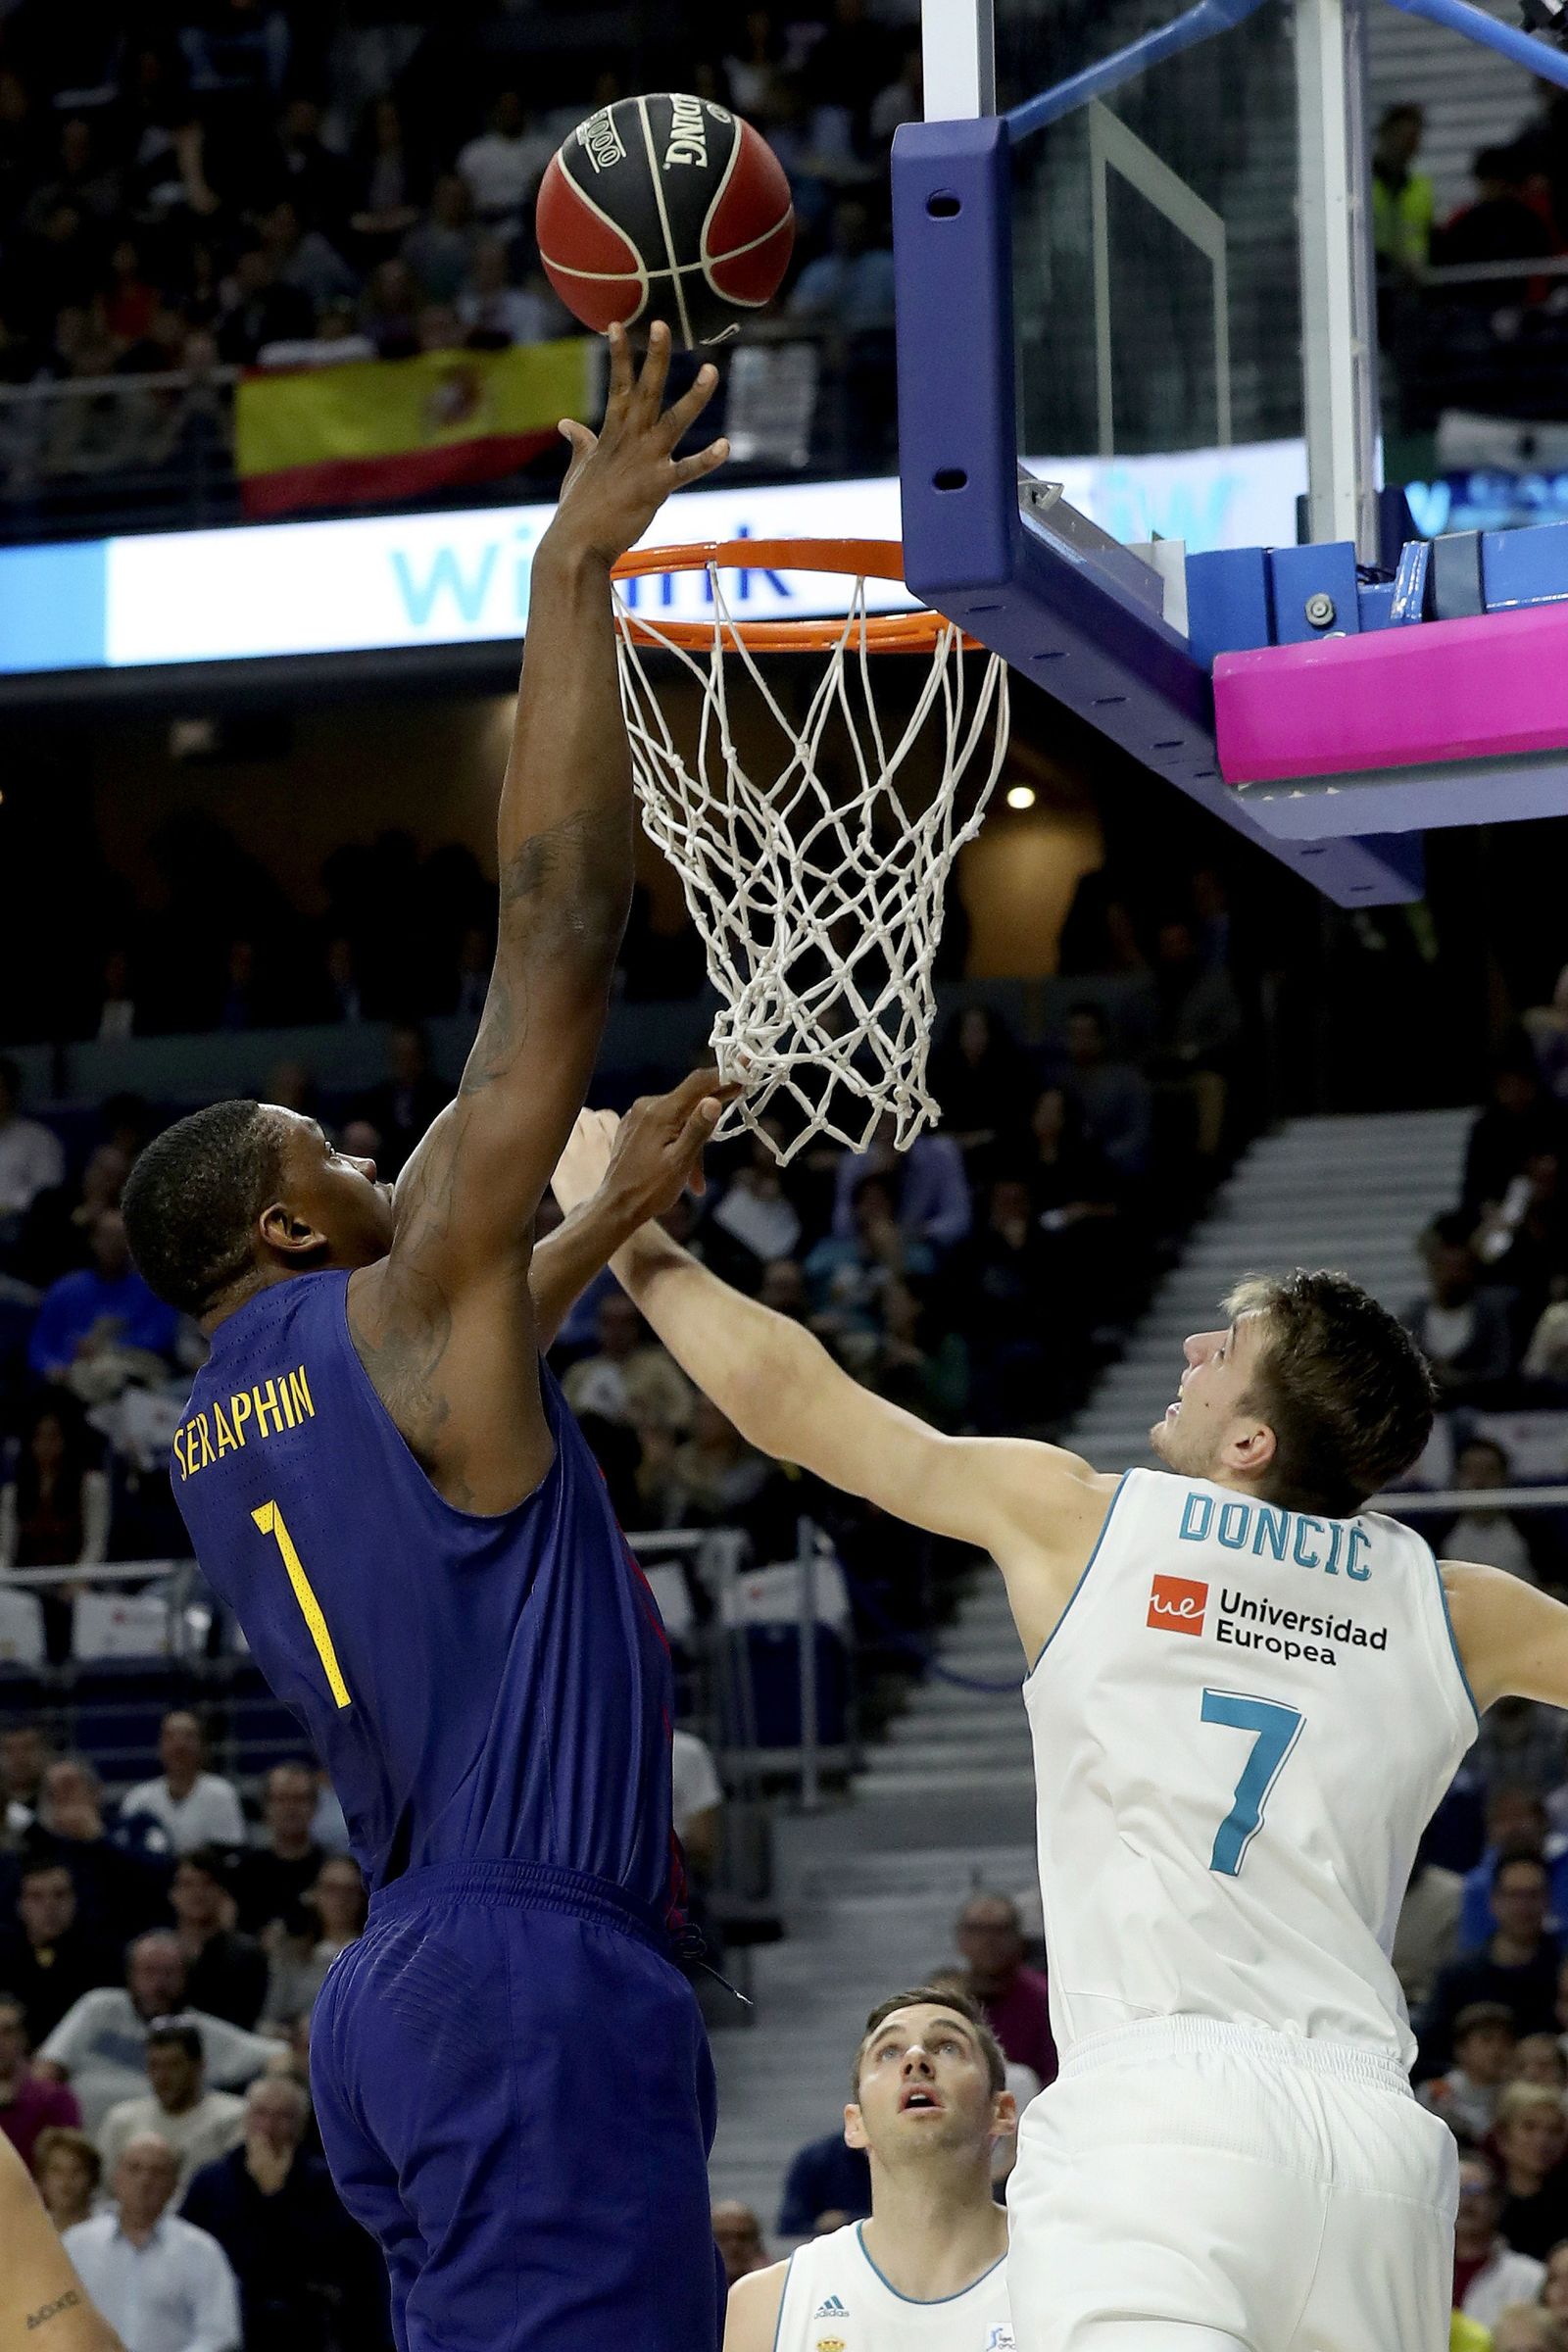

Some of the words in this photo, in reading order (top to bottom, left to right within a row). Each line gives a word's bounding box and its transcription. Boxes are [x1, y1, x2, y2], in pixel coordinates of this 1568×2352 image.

[172, 1364, 315, 1482] SERAPHIN
[251, 1499, 353, 1709] 1
[1215, 1619, 1337, 1666] Europea
[1219, 1588, 1388, 1651] Universidad
[1200, 1688, 1307, 1877] 7
